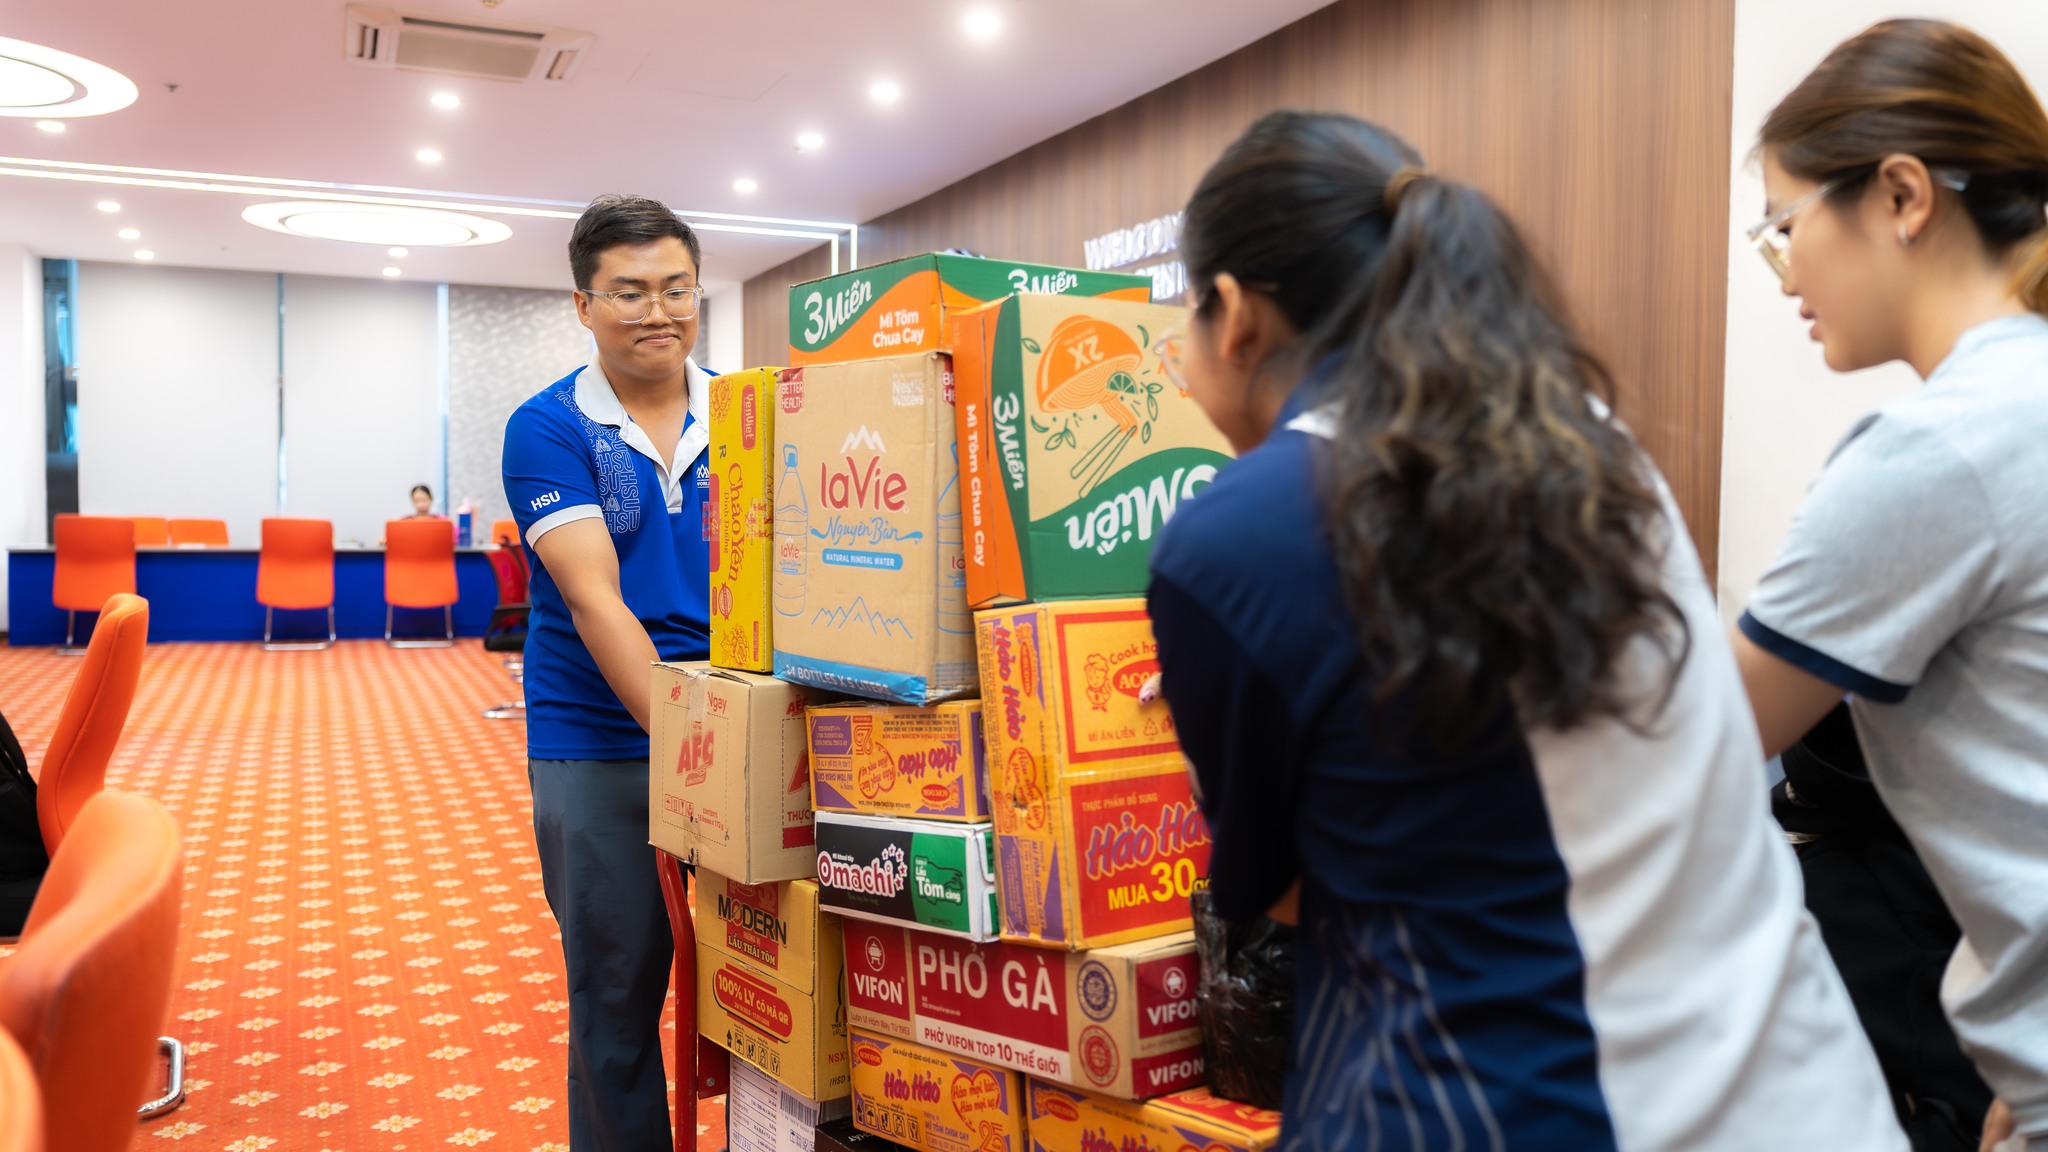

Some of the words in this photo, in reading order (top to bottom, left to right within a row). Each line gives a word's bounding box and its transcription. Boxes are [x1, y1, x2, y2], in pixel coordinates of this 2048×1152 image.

[880, 312, 893, 330] Mì
[894, 309, 919, 326] Tôm
[872, 331, 901, 348] Chua
[902, 327, 925, 345] Cay
[1066, 335, 1104, 370] 2X
[781, 381, 804, 395] BETTER
[781, 396, 804, 410] HEALTH
[966, 404, 977, 428] Mì
[967, 430, 979, 473] Tôm
[531, 490, 561, 511] HSU
[820, 456, 908, 512] laVie
[970, 476, 982, 527] Chua
[825, 553, 849, 562] NATURAL
[850, 555, 873, 565] MINERAL
[874, 556, 895, 566] WATER
[973, 530, 985, 567] Cay
[1109, 643, 1140, 665] Cook
[797, 667, 836, 686] BOTTLES
[854, 678, 892, 696] LITERS
[1085, 812, 1157, 880] Hảo
[817, 850, 896, 898] Omachi
[915, 876, 944, 898] Tôm
[1107, 883, 1151, 911] MUA
[1151, 858, 1196, 902] 30
[718, 893, 787, 948] MODERN
[760, 948, 776, 966] TÔM
[918, 943, 988, 999] PHỞ
[717, 974, 743, 1001] 100%
[743, 987, 755, 1007] LY
[756, 997, 766, 1013] CÓ
[766, 1004, 778, 1020] MÃ
[778, 1010, 789, 1026] QR
[853, 972, 903, 1005] VIFON
[1002, 955, 1058, 1016] GÀ
[925, 1025, 944, 1043] PHỞ
[946, 1031, 974, 1051] VIFON
[976, 1041, 996, 1057] TOP
[997, 1042, 1013, 1062] 10
[1015, 1048, 1035, 1068] THẾ
[883, 1069, 910, 1101] Hảo
[912, 1070, 941, 1104] Hảo
[1149, 1058, 1205, 1086] VIFON
